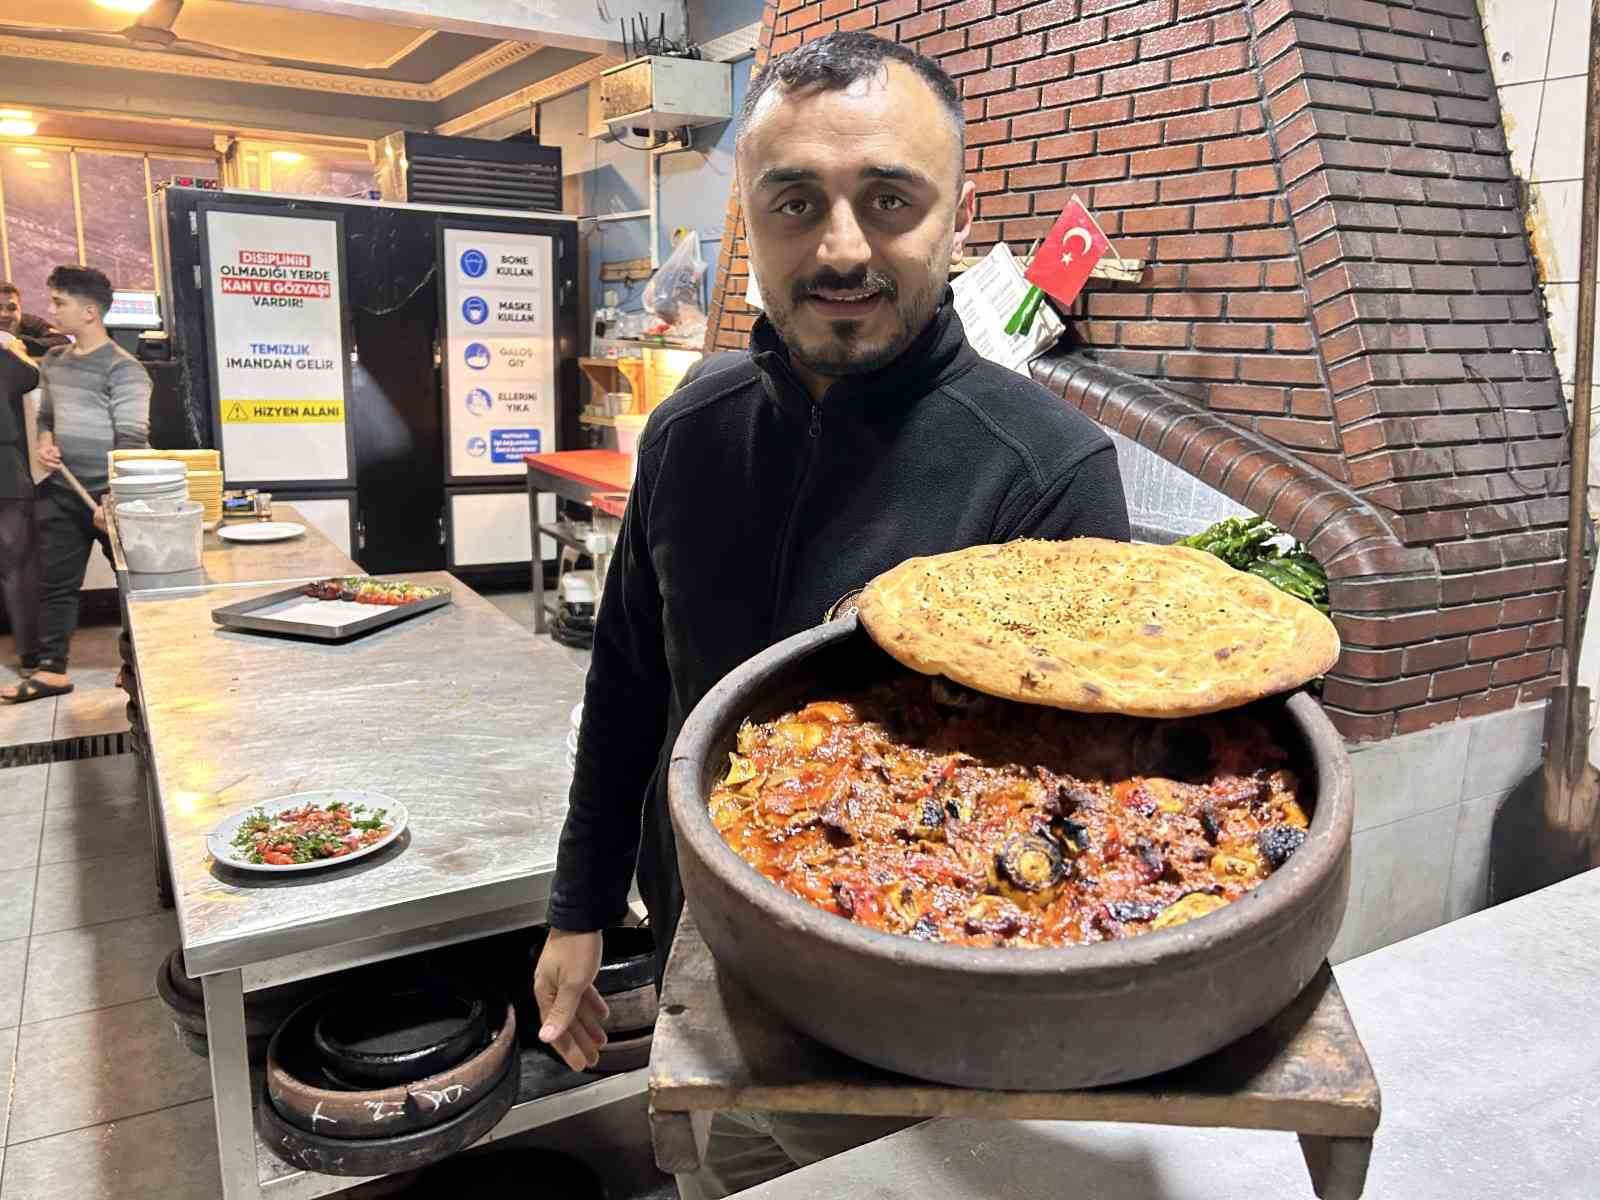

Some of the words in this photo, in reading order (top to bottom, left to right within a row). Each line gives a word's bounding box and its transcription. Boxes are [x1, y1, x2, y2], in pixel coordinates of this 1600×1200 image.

[501, 255, 528, 265] BONE
[290, 270, 331, 281] YERDE
[496, 267, 534, 277] KULLAN
[223, 280, 252, 292] KAN
[254, 283, 272, 293] VE
[273, 281, 330, 298] GÖZYAŞI
[252, 297, 304, 308] VARDIR!
[499, 301, 533, 312] MASKE
[497, 313, 535, 322] KULLAN
[302, 407, 340, 417] ALANI
[506, 404, 530, 413] YIKA
